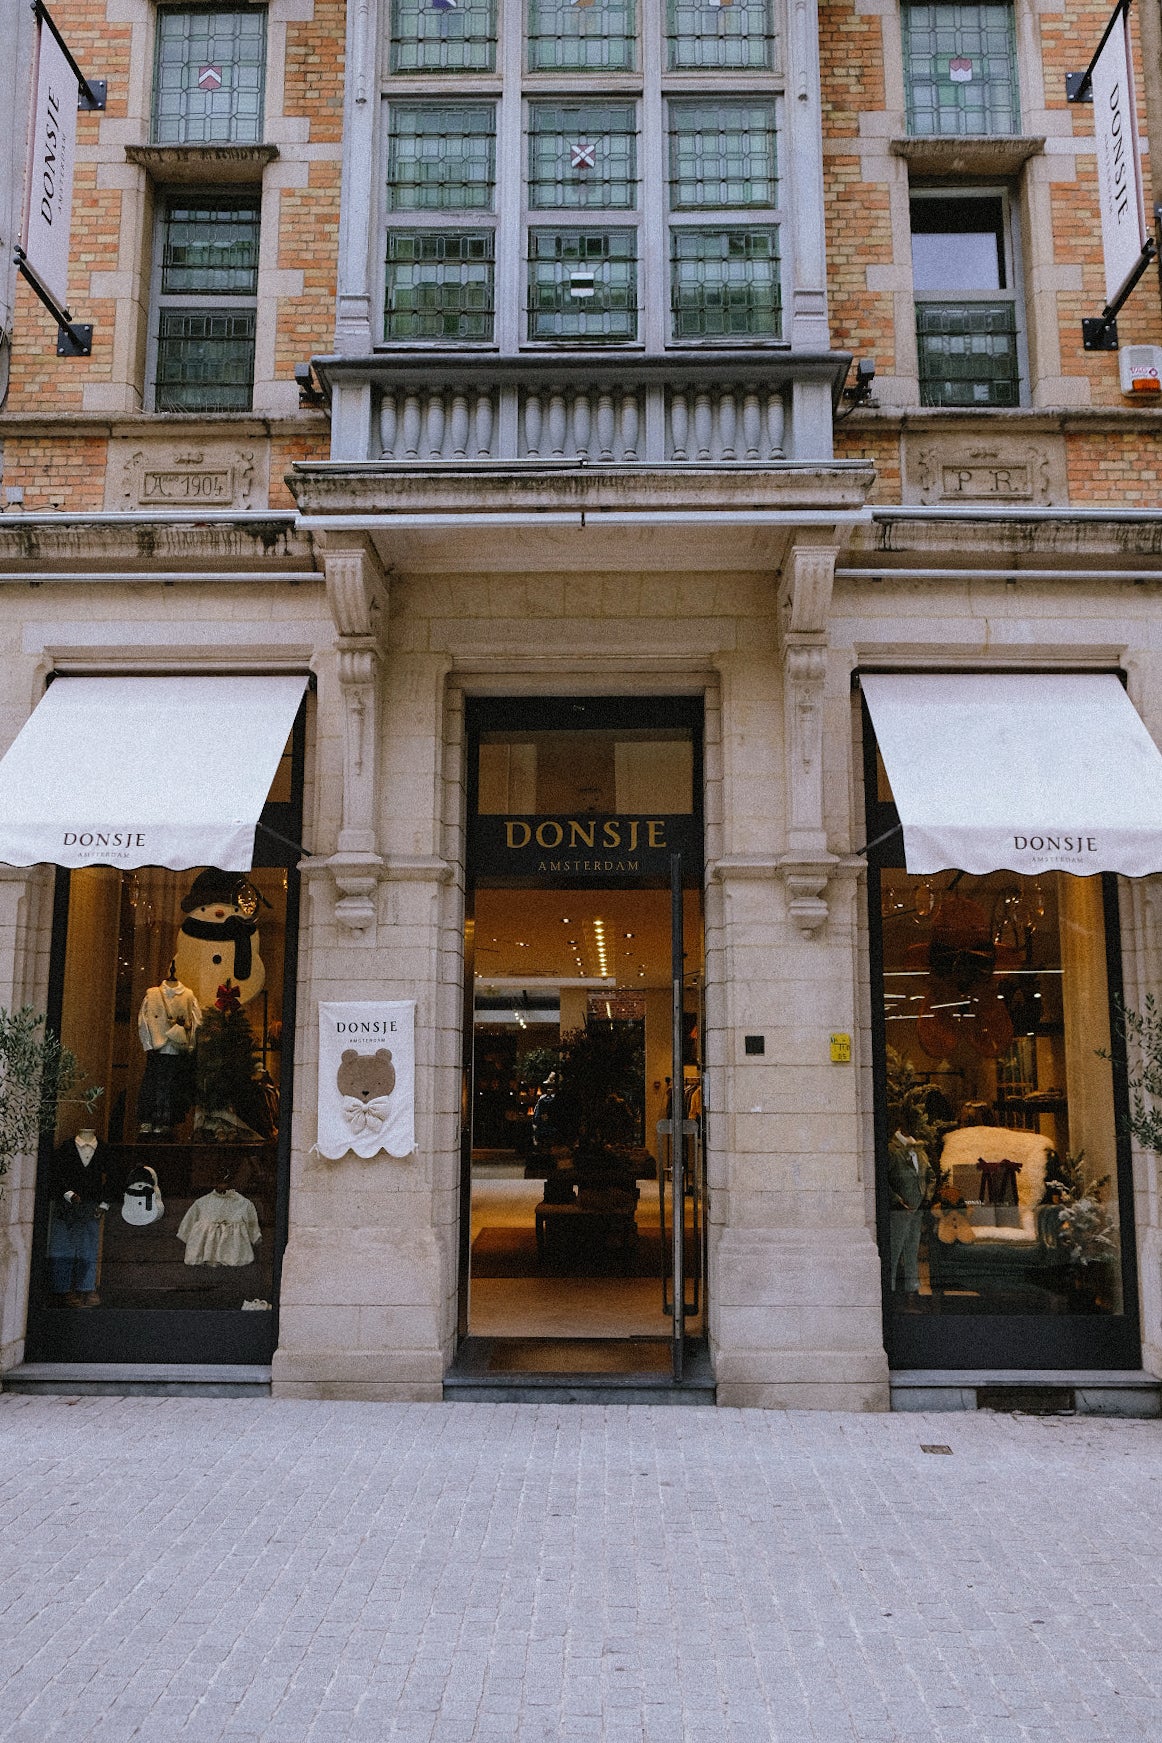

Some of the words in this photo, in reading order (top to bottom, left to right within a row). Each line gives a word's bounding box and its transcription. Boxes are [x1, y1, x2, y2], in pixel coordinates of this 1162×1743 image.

[41, 86, 60, 226] DONSJE
[1109, 82, 1129, 226] DONSJE
[181, 475, 224, 497] 1904
[951, 469, 973, 492] P
[988, 468, 1019, 492] R
[63, 832, 146, 848] DONSJE
[504, 820, 667, 851] DONSJE
[1013, 836, 1098, 853] DONSJE
[538, 860, 640, 871] AMSTERDAM
[336, 1020, 398, 1034] DONSJE
